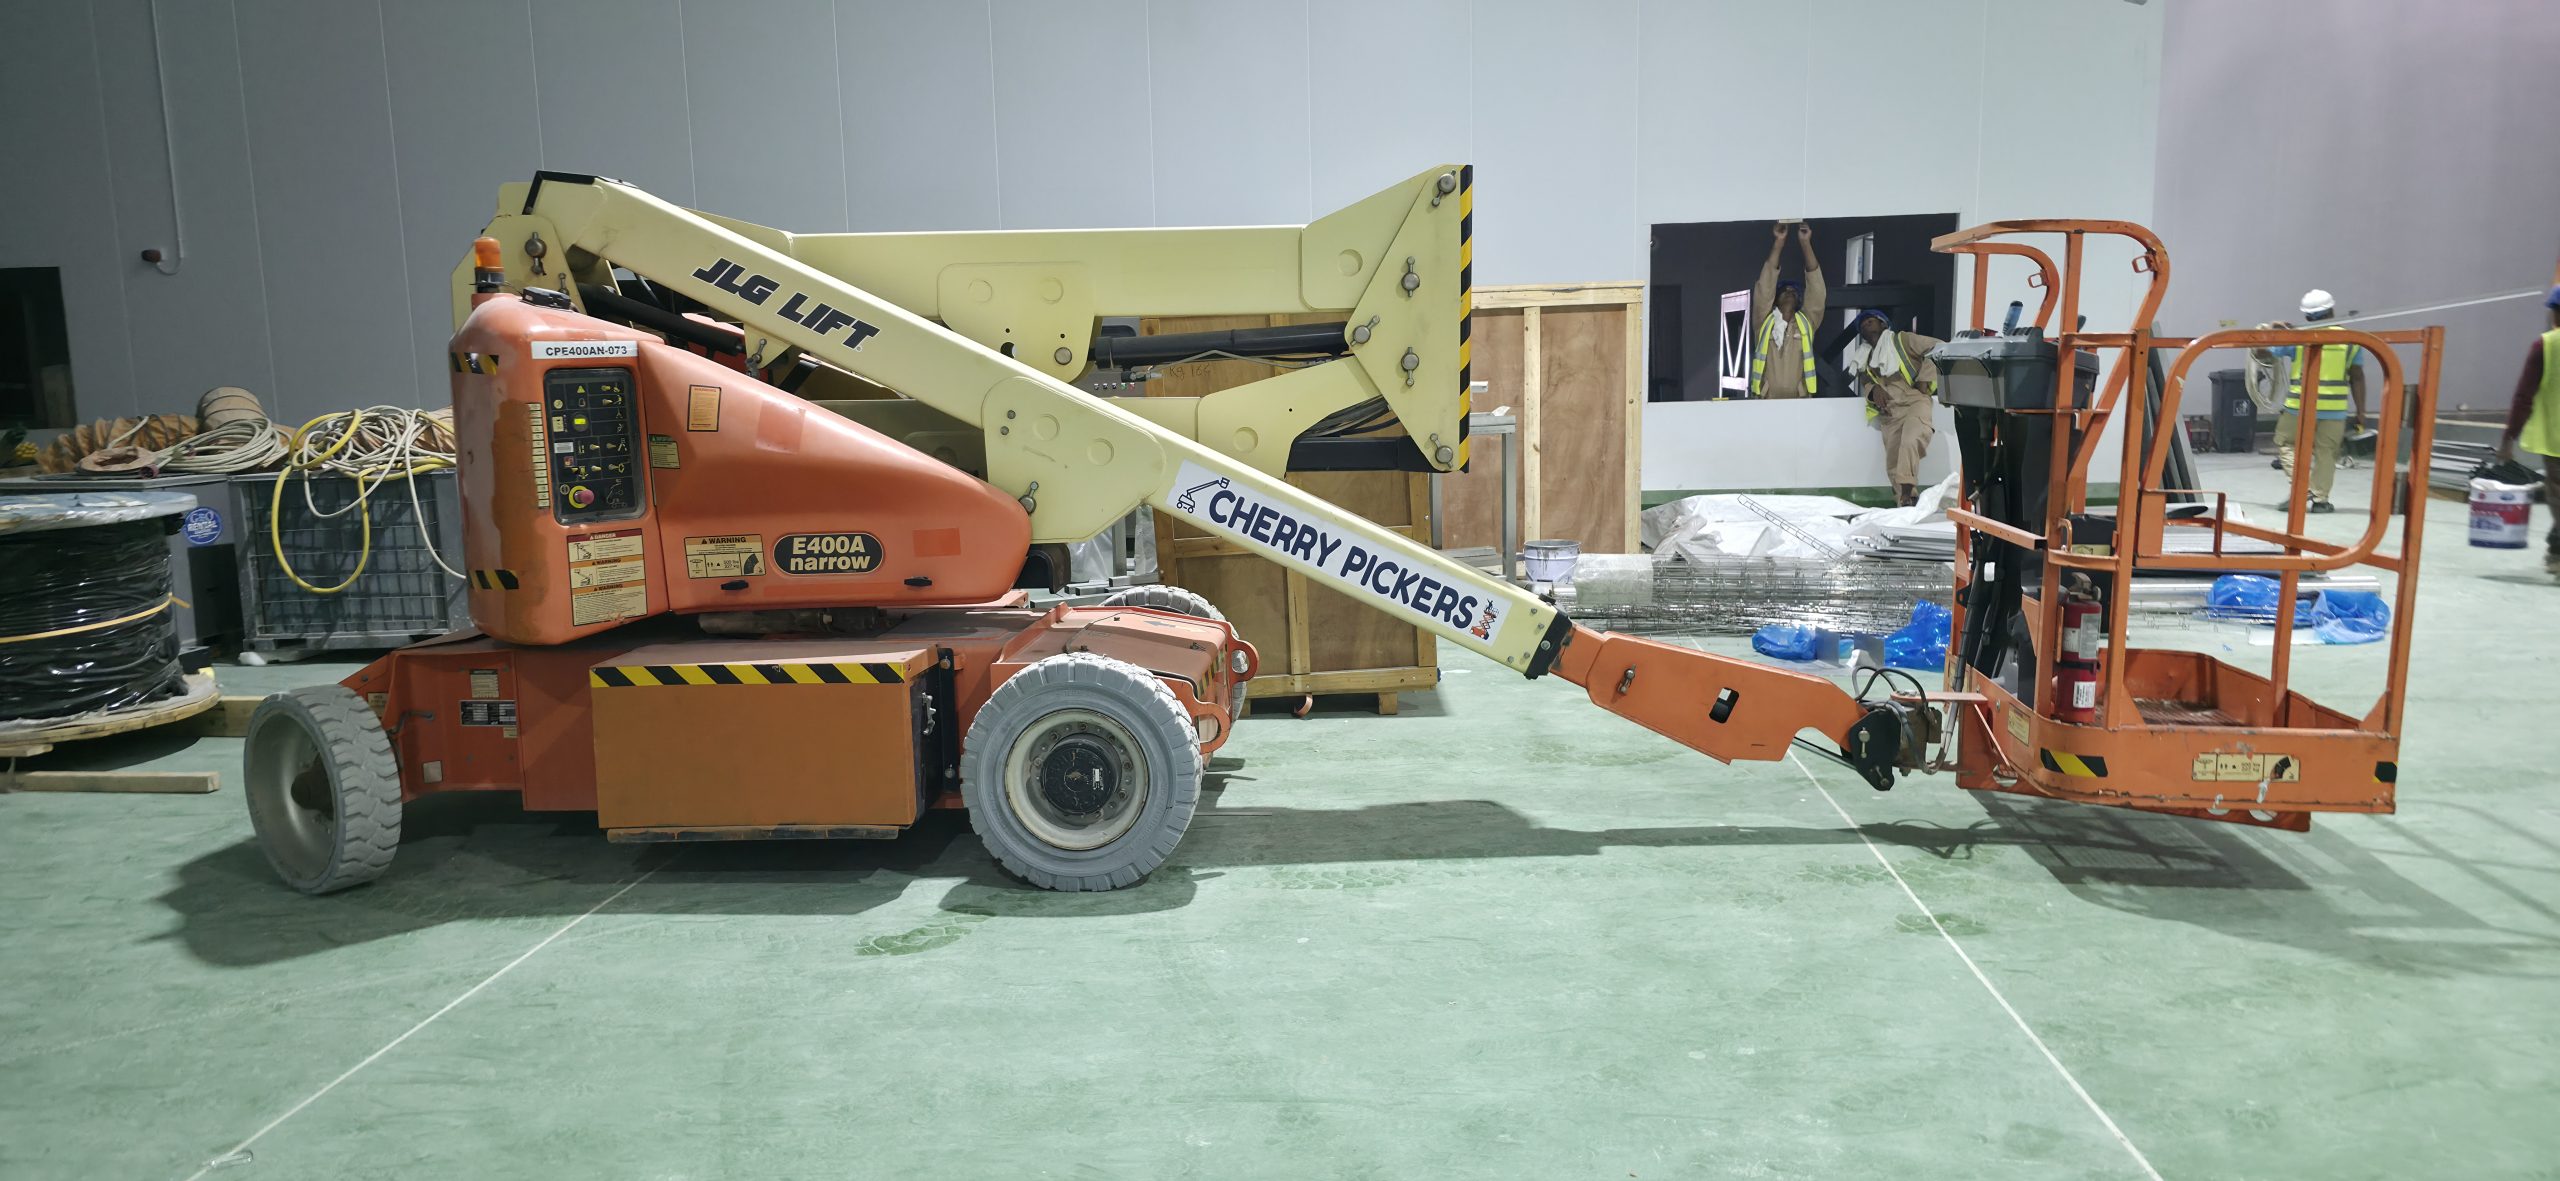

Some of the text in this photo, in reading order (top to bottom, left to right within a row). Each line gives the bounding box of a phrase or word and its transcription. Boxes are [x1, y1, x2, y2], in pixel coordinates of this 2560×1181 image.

[692, 257, 881, 350] JLG LIFT
[545, 346, 628, 356] CPE400AN-073
[792, 535, 866, 555] E400A
[790, 556, 871, 571] narrow
[1208, 489, 1478, 630] CHERRY PICKERS
